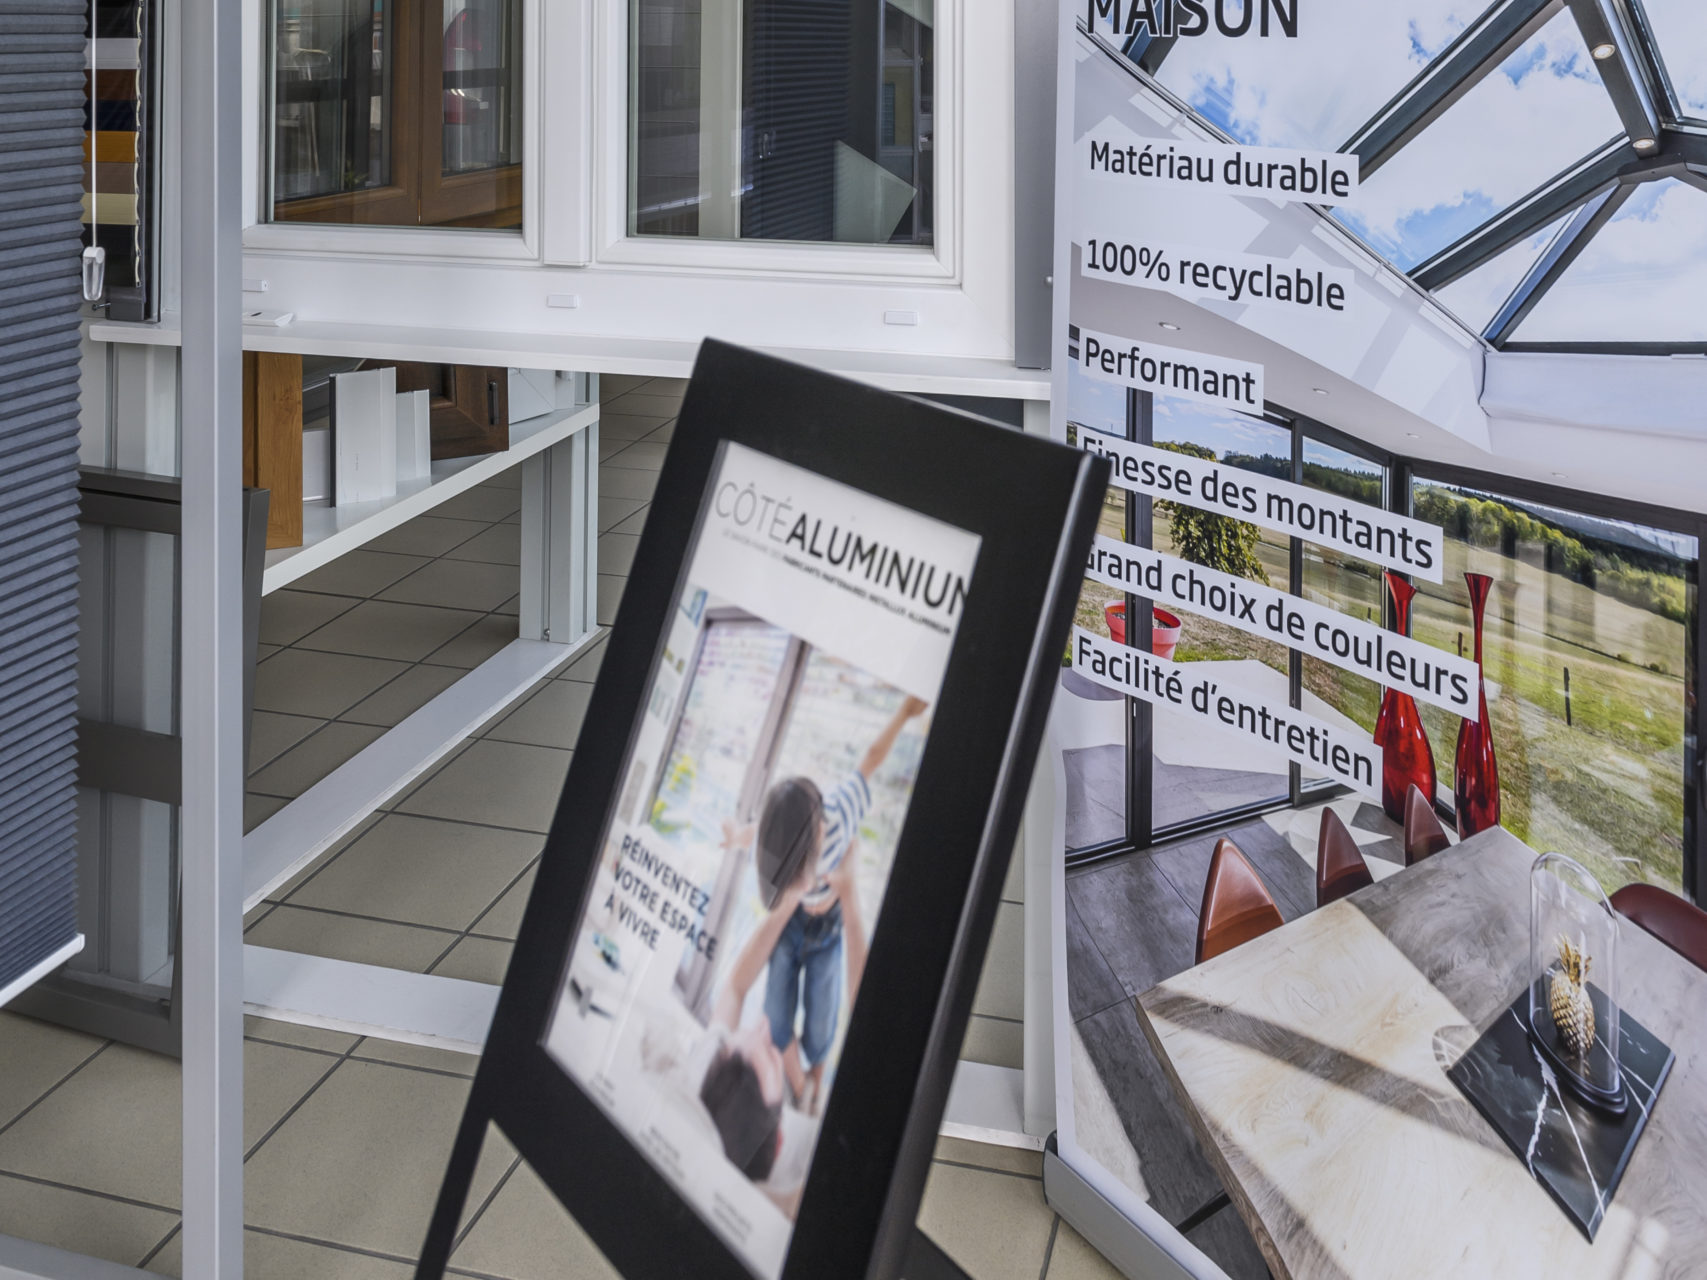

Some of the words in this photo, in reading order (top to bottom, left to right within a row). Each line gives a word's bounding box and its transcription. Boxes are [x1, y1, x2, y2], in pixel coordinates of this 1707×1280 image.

[1090, 140, 1214, 183] Matériau
[1223, 151, 1350, 198] durable
[1087, 238, 1171, 282] 100%
[1179, 259, 1346, 311] recyclable
[1085, 337, 1256, 405] Performant
[1200, 469, 1257, 514] des
[1266, 495, 1433, 570] montants
[1171, 568, 1257, 624] choix
[1265, 598, 1305, 641] de
[1314, 620, 1469, 705] couleurs
[1078, 635, 1183, 705] Facilité
[1191, 680, 1373, 787] d'entretien
[613, 862, 657, 912] VOTRE
[659, 901, 718, 962] ESPACE
[617, 900, 661, 951] VIVRE
